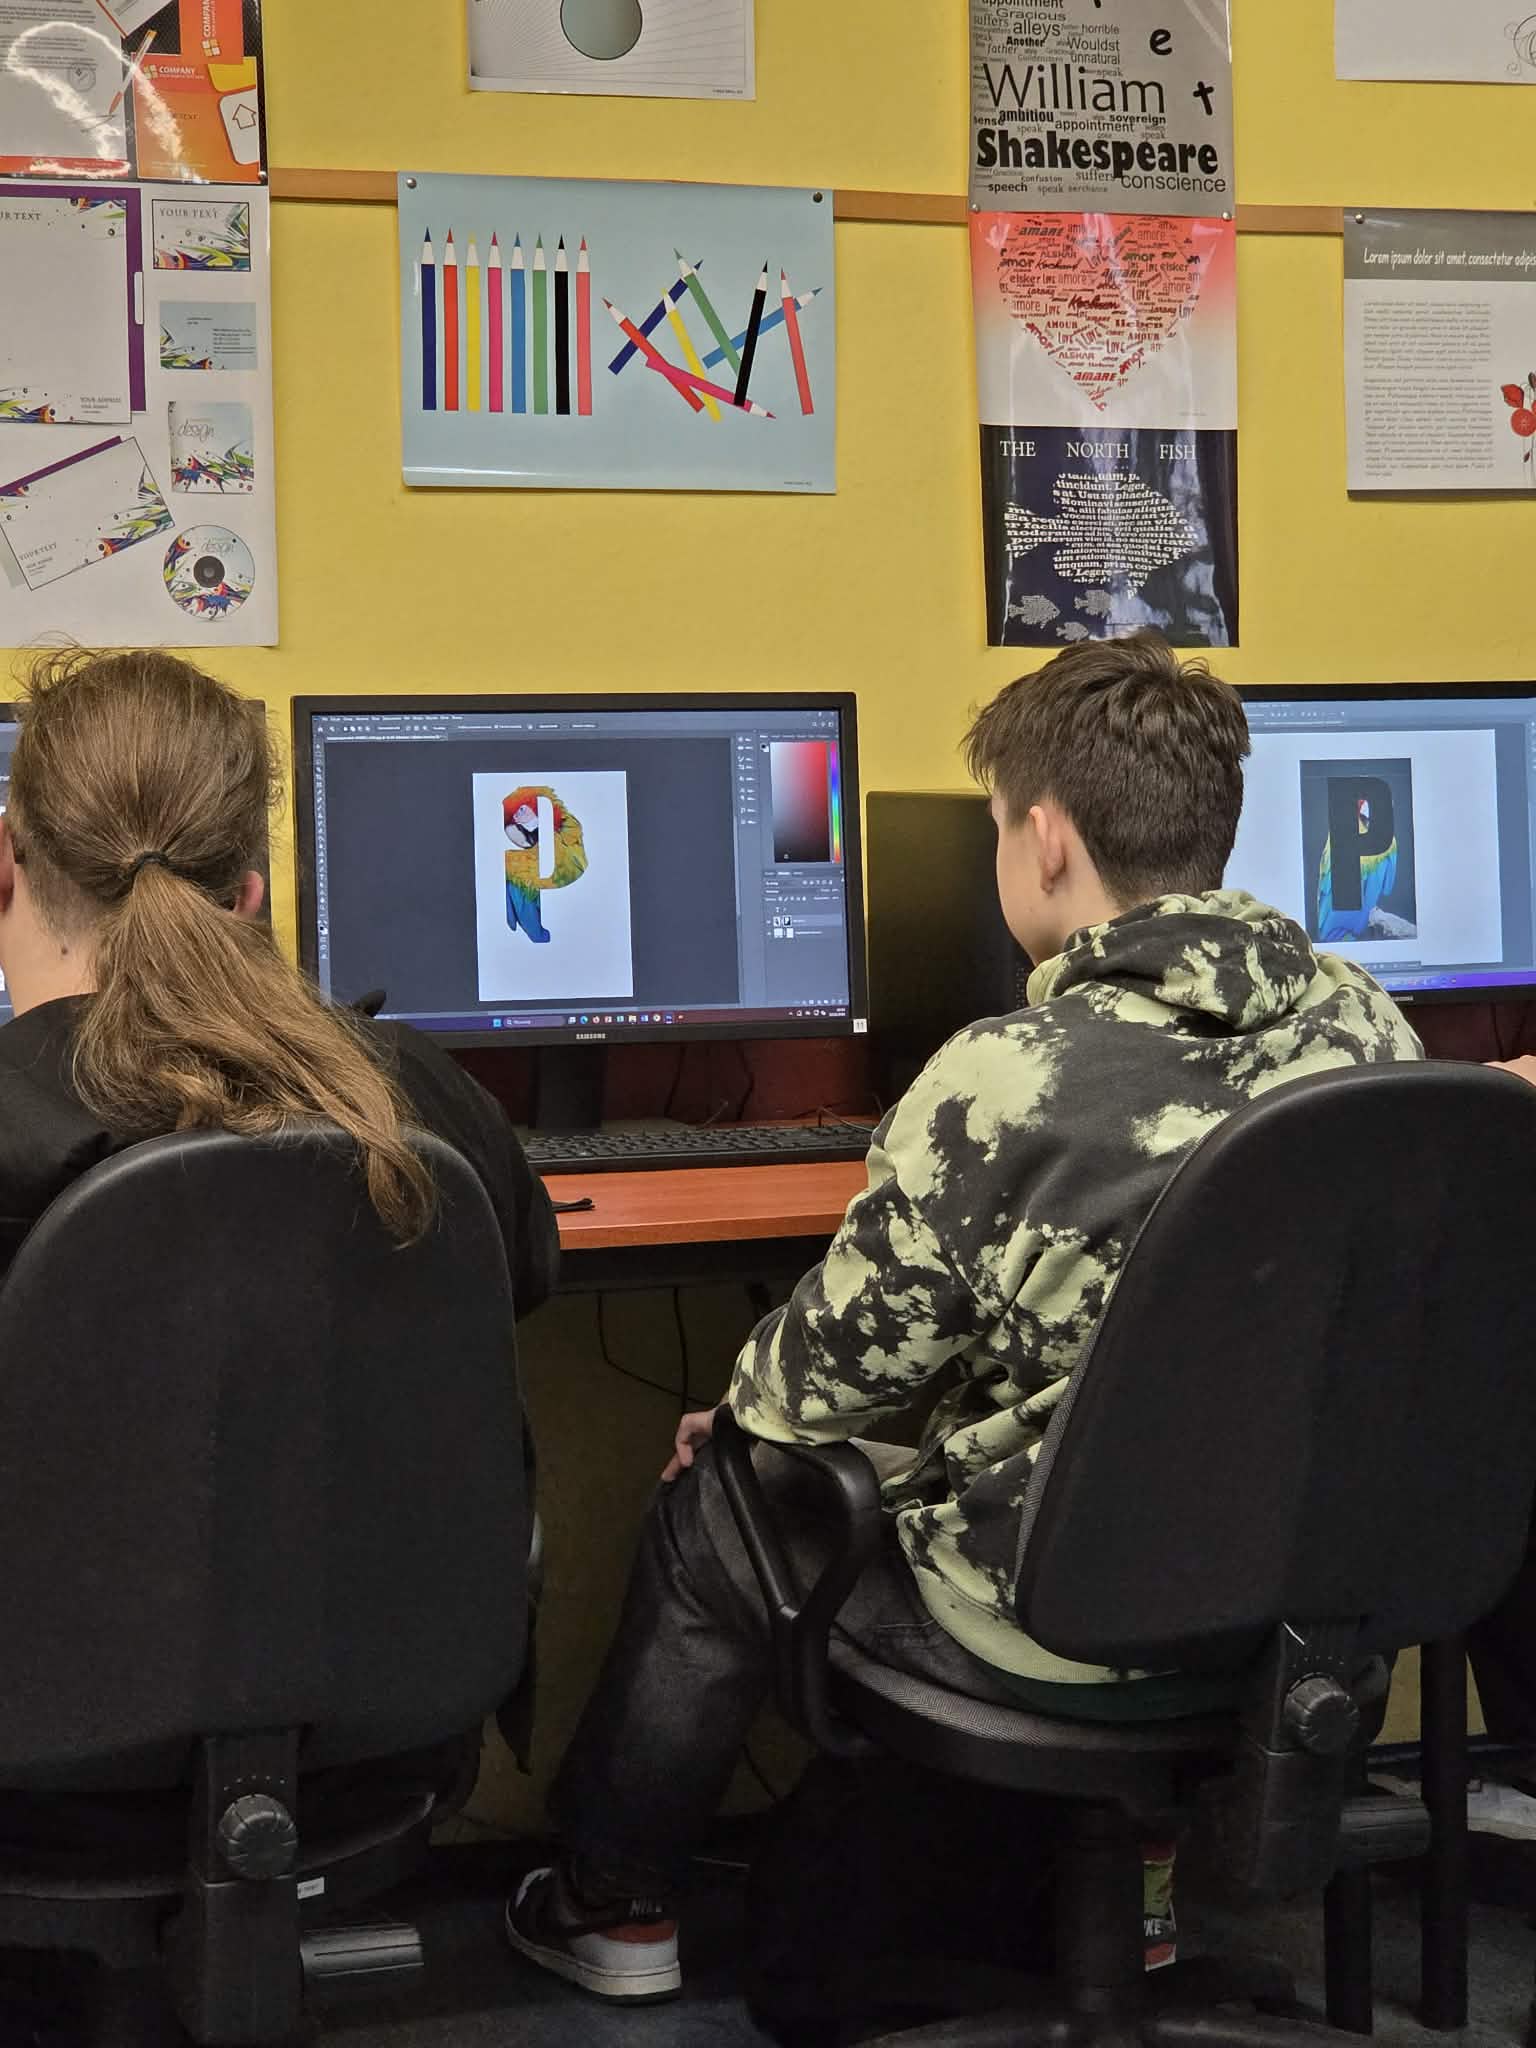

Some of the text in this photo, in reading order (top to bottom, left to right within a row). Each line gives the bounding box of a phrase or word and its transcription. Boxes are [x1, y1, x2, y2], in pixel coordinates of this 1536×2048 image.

[997, 8, 1066, 21] Gracious
[1013, 19, 1061, 40] alleys
[1081, 23, 1120, 35] horrible
[1006, 36, 1045, 47] Another
[1067, 38, 1120, 52] Wouldst
[1149, 28, 1173, 56] e
[1070, 54, 1120, 65] unnatural
[159, 65, 196, 75] COMPANY
[983, 63, 1165, 114] William
[1192, 81, 1215, 116] t
[999, 109, 1055, 123] ambitiou
[1109, 113, 1167, 126] sovereign
[1055, 118, 1135, 133] appointment
[976, 128, 1219, 178] Shakespeare
[988, 182, 1028, 193] speech
[1120, 172, 1227, 193] conscience
[14, 212, 41, 221] TEXT
[160, 207, 189, 217] YOUR
[1363, 247, 1390, 264] Lorem
[1390, 250, 1413, 270] ipsum
[1413, 248, 1433, 265] dolor
[1434, 250, 1445, 265] sit
[1468, 252, 1513, 266] consectetur
[1000, 441, 1196, 460] THE NORTH FISH
